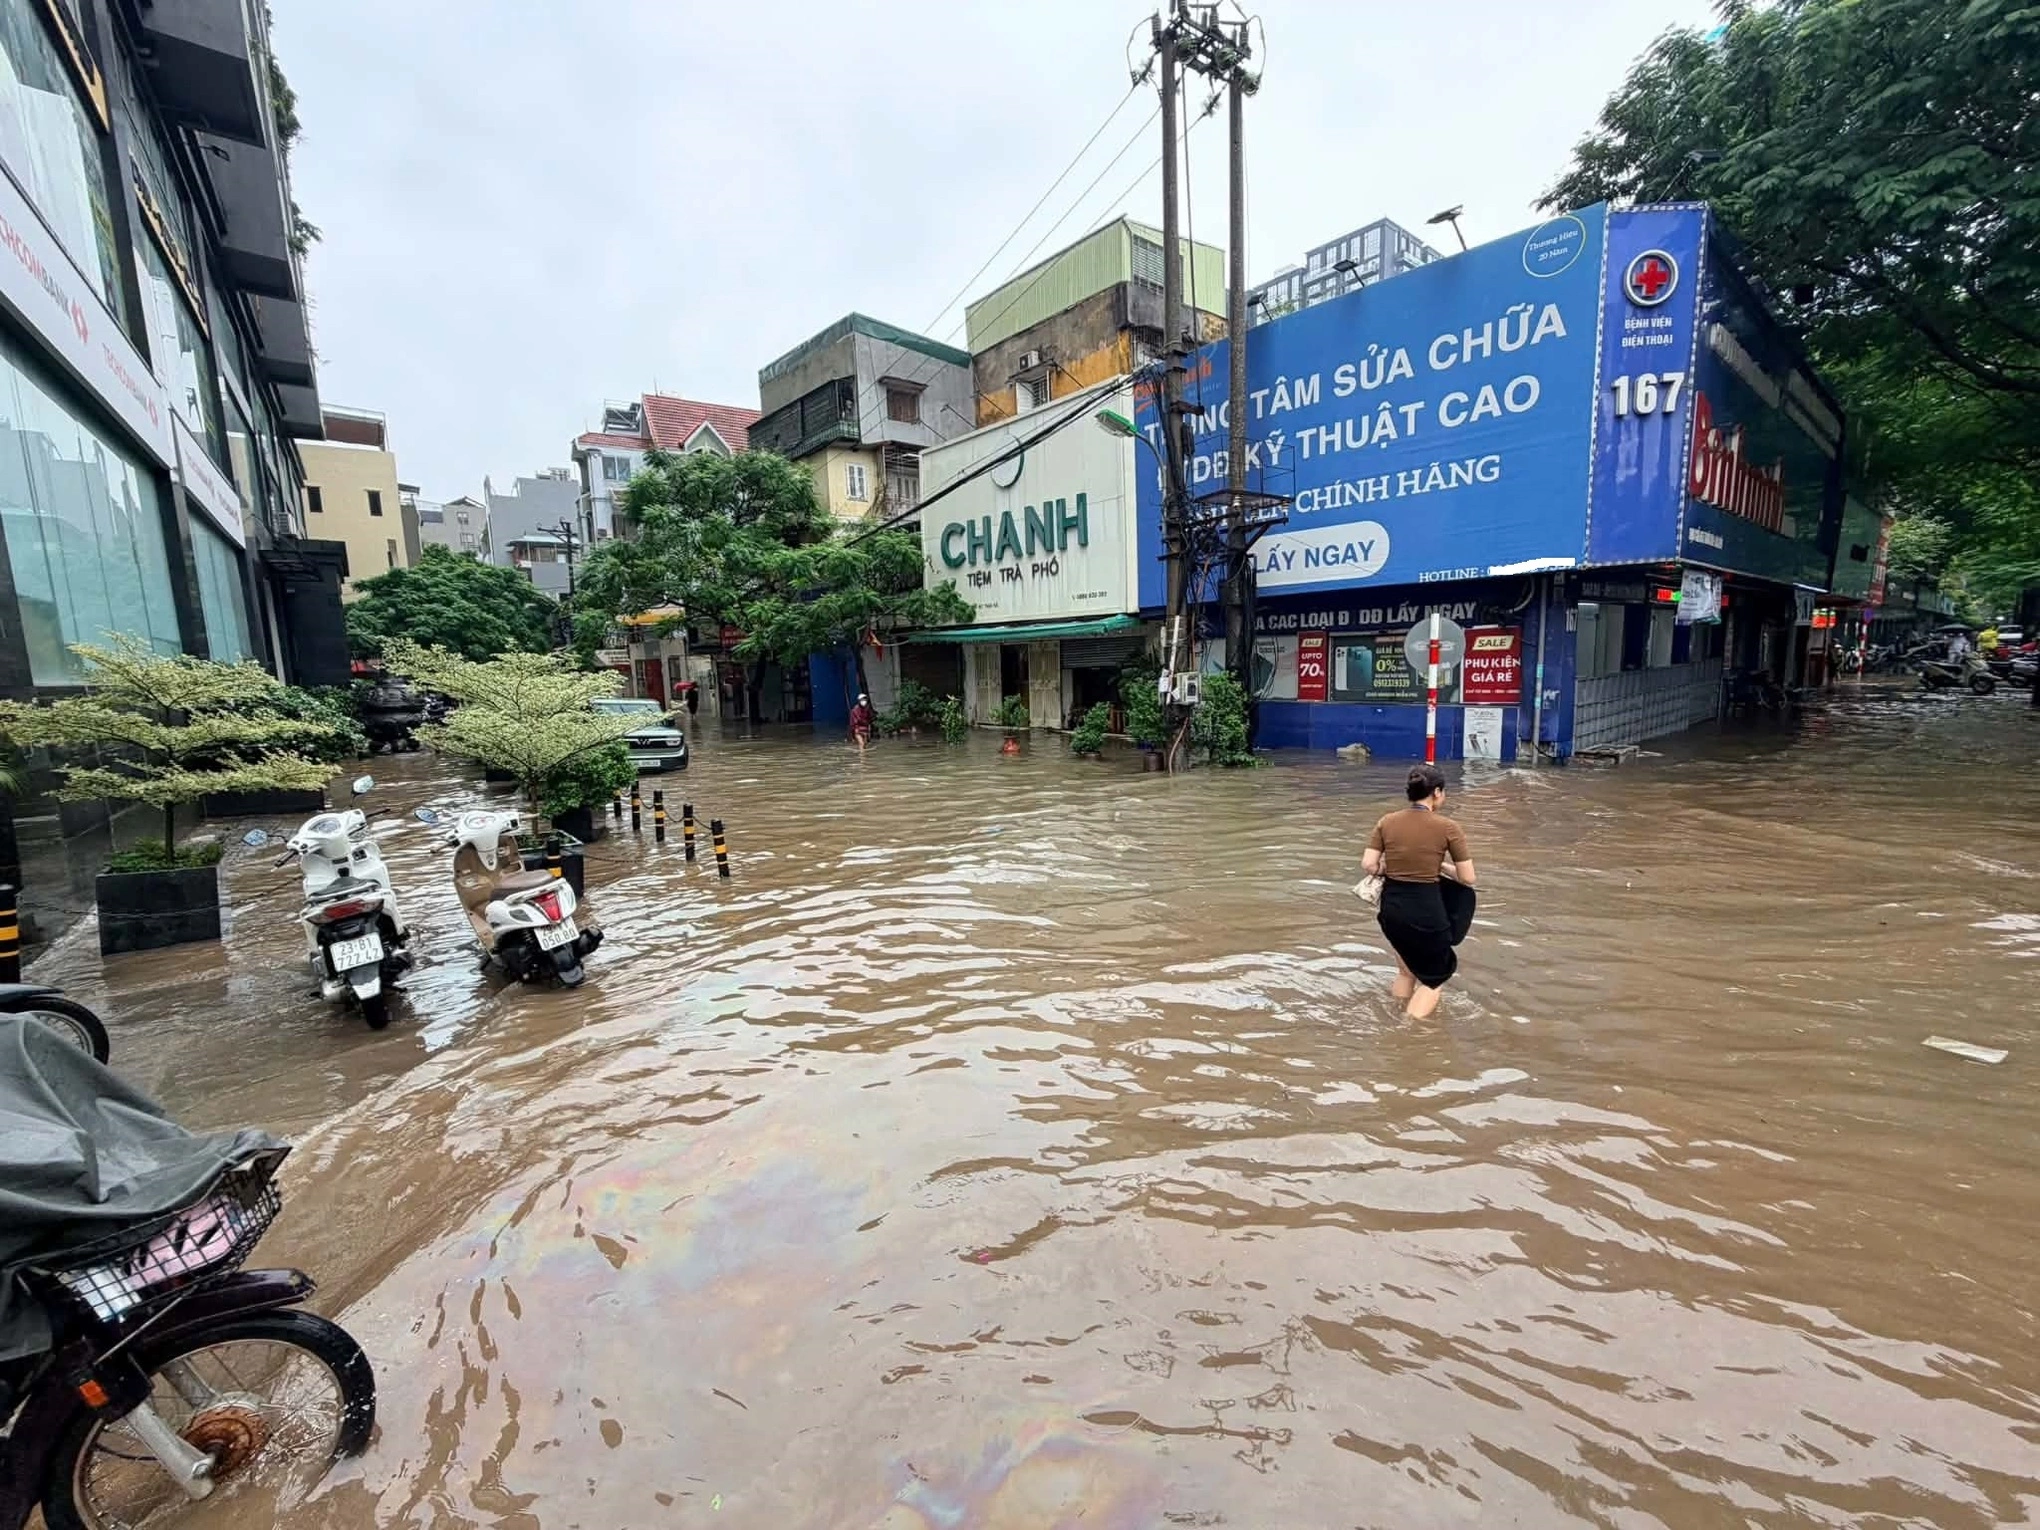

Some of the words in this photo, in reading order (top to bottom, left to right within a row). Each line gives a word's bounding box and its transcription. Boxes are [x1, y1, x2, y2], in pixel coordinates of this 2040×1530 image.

[1250, 372, 1321, 419] TÂM
[1333, 343, 1414, 397] SỬA
[1428, 302, 1567, 371] CHỮA
[1611, 372, 1685, 417] 167
[1245, 428, 1286, 472] KỸ
[1296, 401, 1425, 460] THUẬT
[1438, 374, 1541, 428] CAO
[1295, 475, 1390, 513] CHÍNH
[1396, 454, 1500, 497] HÃNG
[940, 492, 1089, 569] CHANH
[1304, 539, 1376, 568] NGAY
[967, 570, 992, 589] TIỆM
[1000, 562, 1024, 583] TRÀ
[1032, 555, 1060, 580] PHỐ
[1418, 567, 1479, 583] HOTLINE
[1300, 611, 1334, 630] LOẠI
[1386, 601, 1419, 624] LẤY
[1424, 602, 1477, 621] NGAY
[1566, 607, 1578, 633] 167
[1477, 638, 1507, 647] SALE
[1375, 659, 1397, 672] 0%
[1471, 670, 1495, 683] GIÁ
